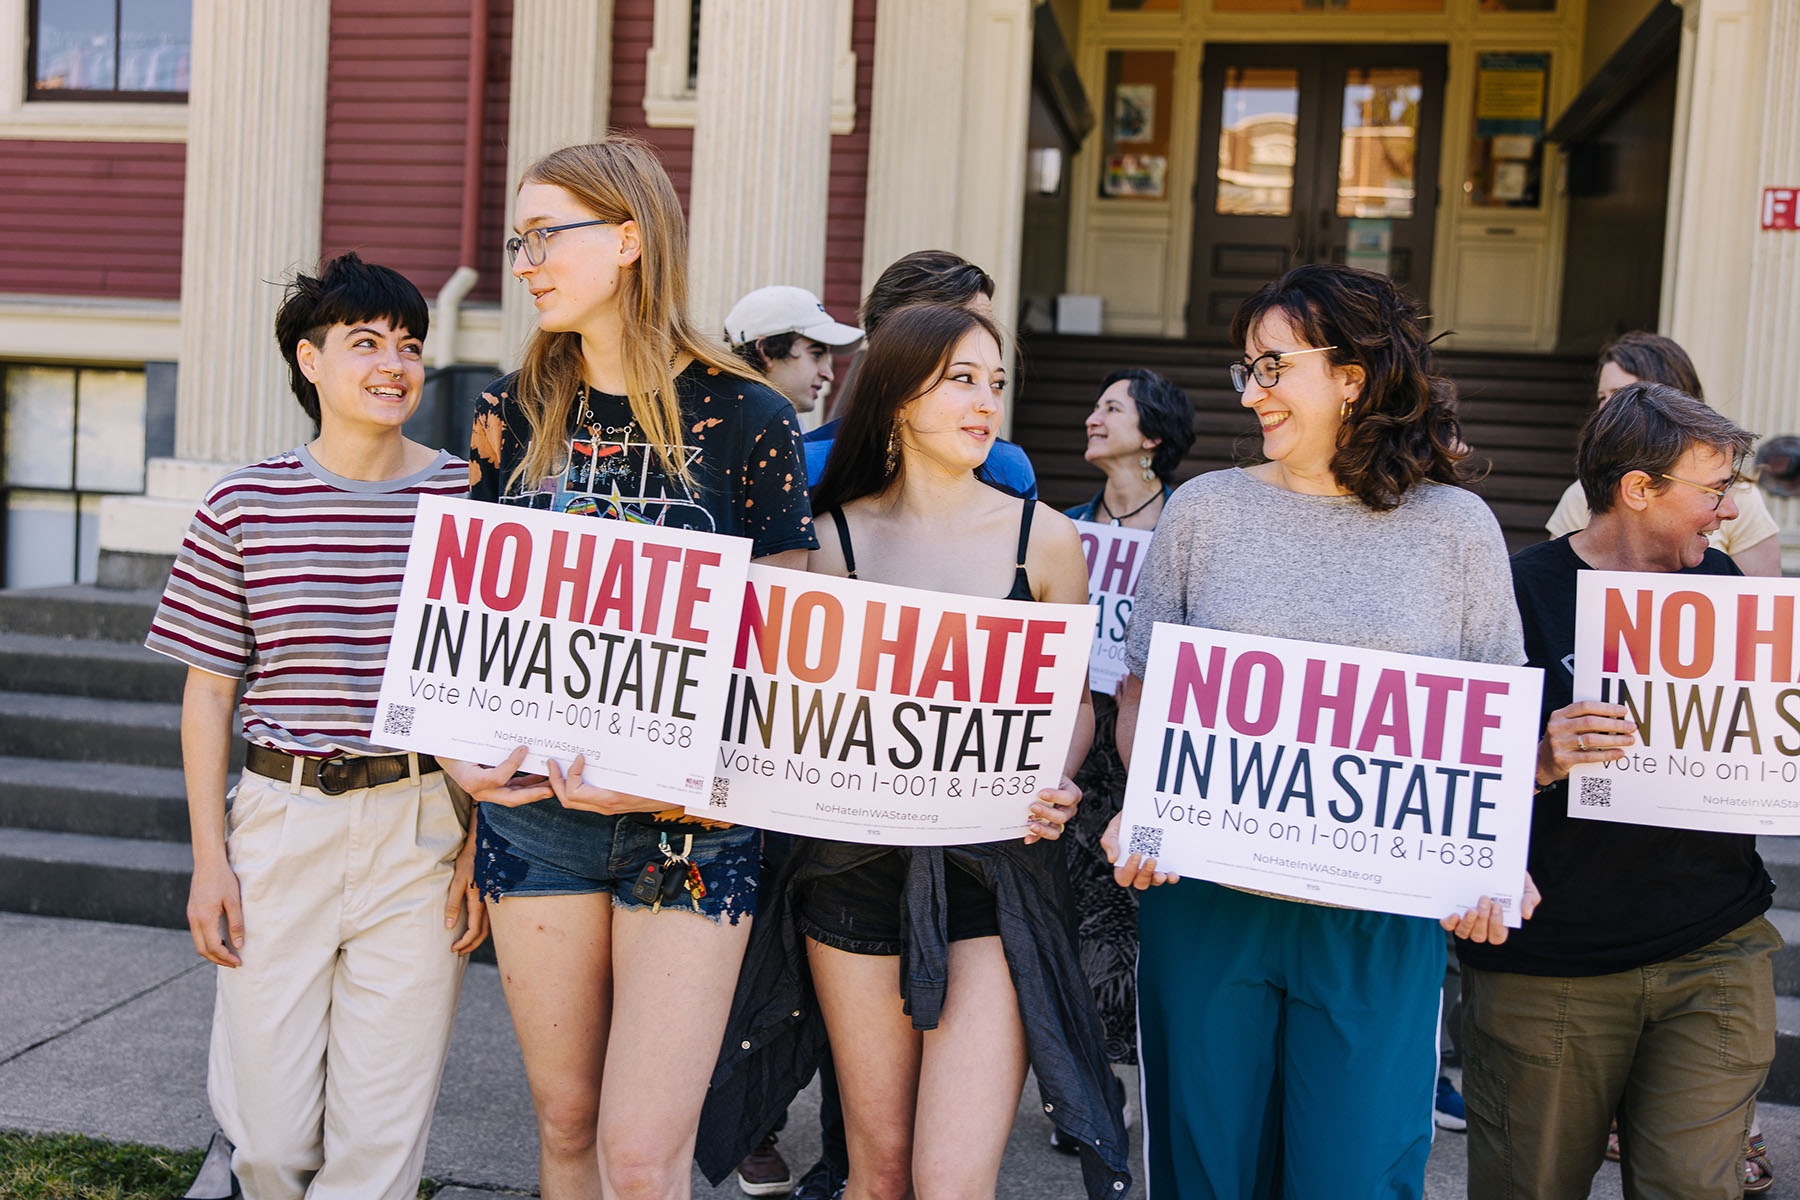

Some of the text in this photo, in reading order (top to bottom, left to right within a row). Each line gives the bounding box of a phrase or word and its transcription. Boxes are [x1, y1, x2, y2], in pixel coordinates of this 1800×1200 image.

[427, 514, 722, 644] NO HATE
[411, 604, 706, 721] IN WA STATE
[733, 580, 844, 684] NO
[856, 600, 1067, 705] HATE
[1602, 588, 1800, 683] NO H
[409, 676, 693, 748] Vote No on I-001 & I-638
[721, 673, 1052, 773] IN WA STATE
[1167, 641, 1510, 768] NO HATE
[1666, 682, 1762, 755] WA
[720, 746, 1037, 798] Vote No on I-001 & I-638
[1156, 727, 1502, 841] IN WA STATE
[1668, 754, 1705, 778] No
[1716, 763, 1749, 781] on
[816, 802, 939, 823] NoHateInWAState.org
[1153, 797, 1495, 869] Vote No on I-001 & I-638
[1253, 852, 1382, 884] NoHateInWAState.org
